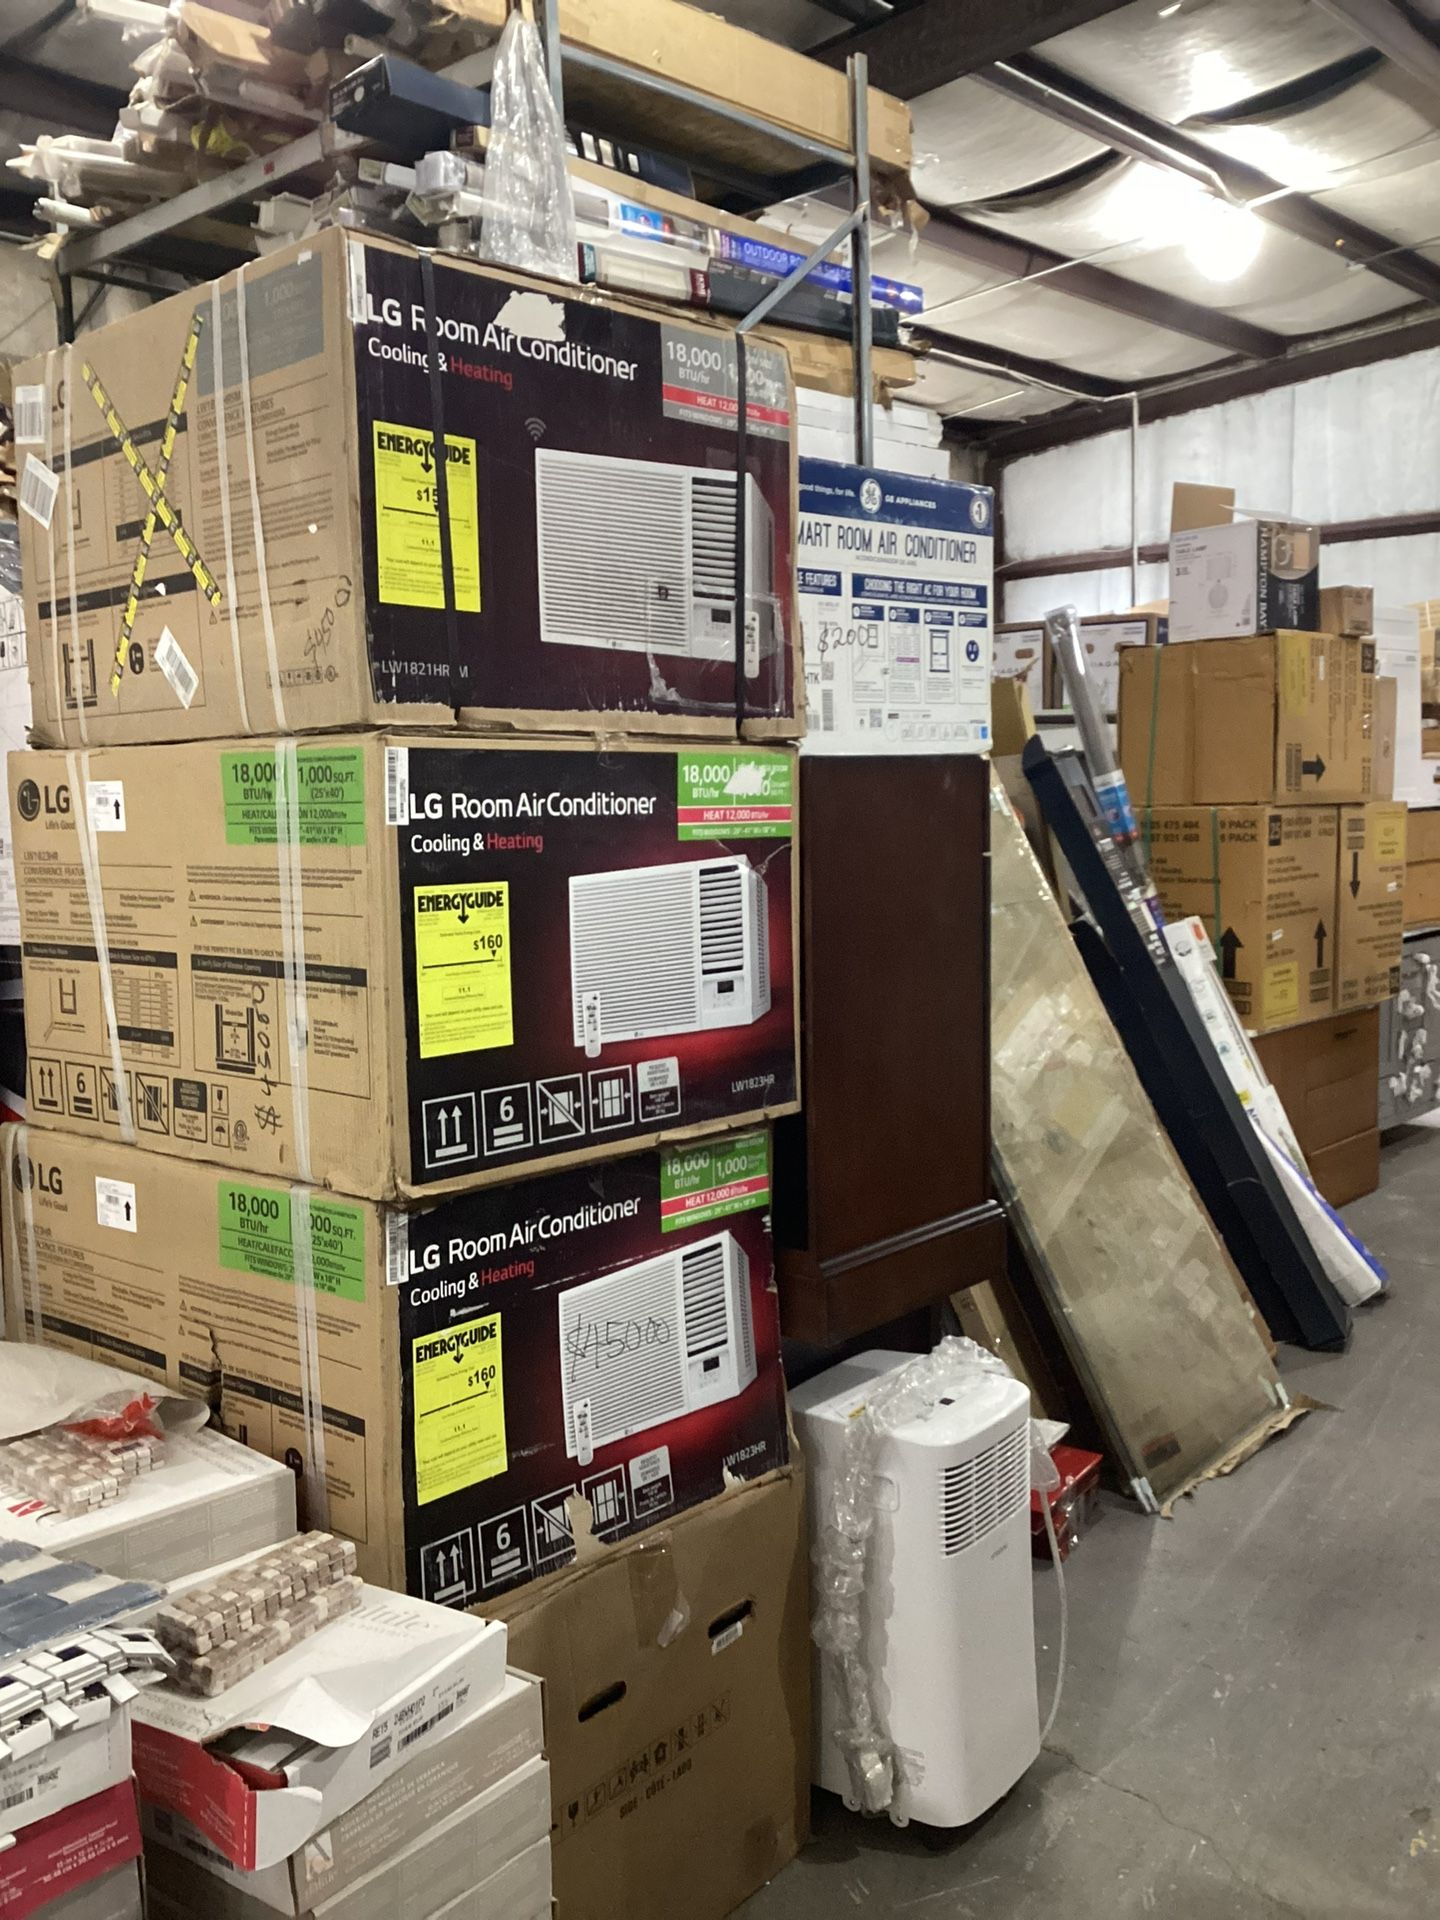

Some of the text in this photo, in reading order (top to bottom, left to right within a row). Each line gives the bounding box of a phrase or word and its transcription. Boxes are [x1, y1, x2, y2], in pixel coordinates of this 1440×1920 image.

[744, 242, 788, 263] OUTDOOR
[367, 295, 401, 327] LG
[368, 337, 513, 391] Cooling & Heating
[665, 340, 721, 373] 18,000
[678, 367, 711, 386] BTU/hr
[896, 496, 937, 510] APPLIANCES
[799, 520, 976, 564] MART ROOM AIR CONDITIONER
[1259, 526, 1269, 628] HAMPTON BAY
[382, 659, 469, 679] LW1821HRM
[298, 765, 332, 787] 1,000
[683, 764, 730, 787] 18,000
[44, 784, 70, 814] LG
[410, 791, 656, 821] LG Room Air Conditioner
[703, 810, 725, 821] HEAT
[726, 809, 751, 820] 12,000
[1229, 820, 1258, 830] PACK
[411, 831, 544, 857] Cooling & Heating
[1229, 832, 1258, 843] PACK
[418, 890, 504, 913] ENERGYGUIDE
[473, 934, 503, 951] $160
[76, 1071, 86, 1094] 6
[731, 1073, 776, 1095] LW1823HR
[499, 1095, 515, 1123] 6
[666, 1151, 747, 1179] 18,000 1,000
[38, 1163, 63, 1196] LG
[229, 1191, 279, 1220] 18,000
[685, 1195, 706, 1209] HEAT
[706, 1189, 730, 1203] 12,000
[240, 1217, 268, 1234] BTU/hr
[410, 1197, 641, 1275] LG Room Air Conditioner
[410, 1259, 535, 1307] Cooling & Heating
[416, 1322, 497, 1363] ENERGYGUIDE
[468, 1365, 496, 1387] $160
[496, 1522, 512, 1550] 6
